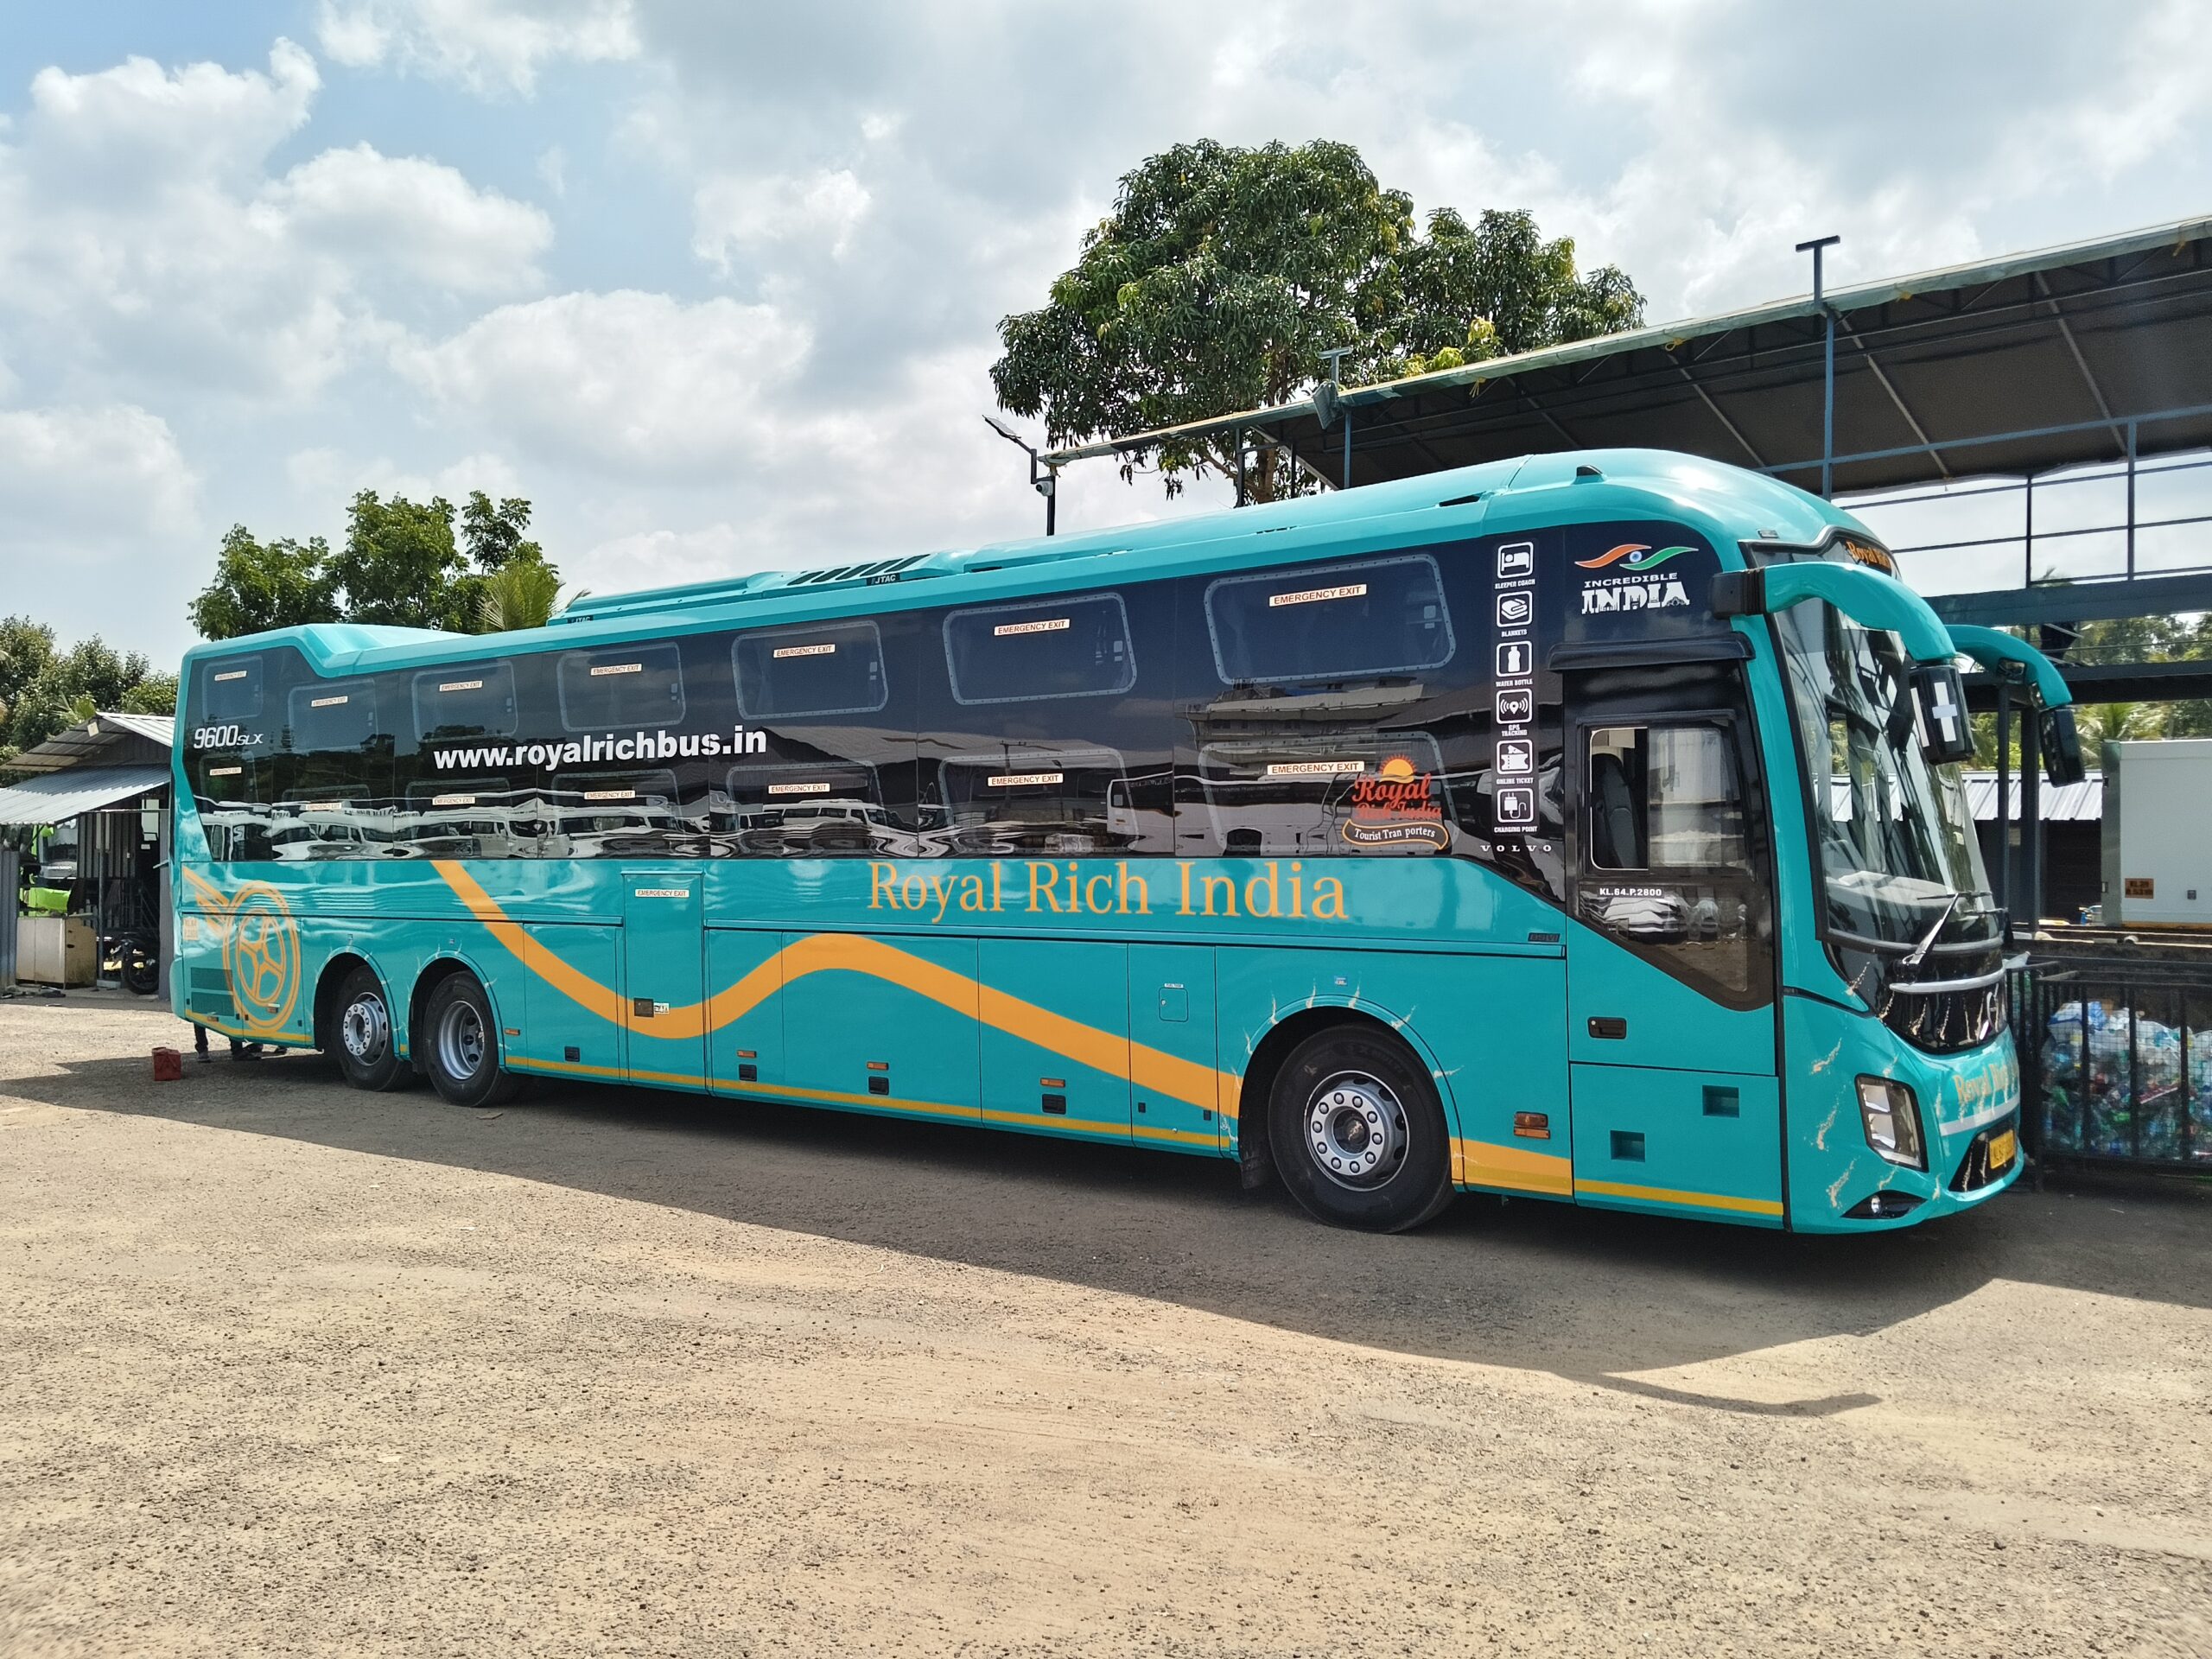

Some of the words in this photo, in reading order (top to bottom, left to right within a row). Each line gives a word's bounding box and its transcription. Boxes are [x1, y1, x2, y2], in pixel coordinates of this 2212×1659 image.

[1584, 572, 1678, 588] INCREDIBLE
[1274, 589, 1337, 605] EMERGENCY
[1338, 586, 1362, 596] EXIT
[1581, 582, 1690, 614] INDIA
[998, 622, 1046, 634] EMERGENCY
[1048, 620, 1065, 629] EXIT
[1501, 629, 1528, 638] BLANKETS
[776, 646, 817, 657] EMERGENCY
[593, 665, 626, 674] EMERGENCY
[434, 725, 767, 771] www.royalrichbus.in
[1272, 763, 1335, 774] EMERGENCY
[1337, 762, 1359, 772] EXIT
[991, 776, 1040, 785] EMERGENCY
[1041, 774, 1059, 783] EXIT
[772, 785, 811, 793] EMERGENCY
[1351, 772, 1433, 809] Royal
[1354, 828, 1382, 841] Tourist
[1382, 829, 1402, 839] Tran
[1405, 826, 1435, 839] porters
[867, 861, 1005, 924] Royal
[1024, 861, 1154, 915] Rich
[1175, 861, 1349, 919] India
[1599, 887, 1662, 896] KL.64.P.2800
